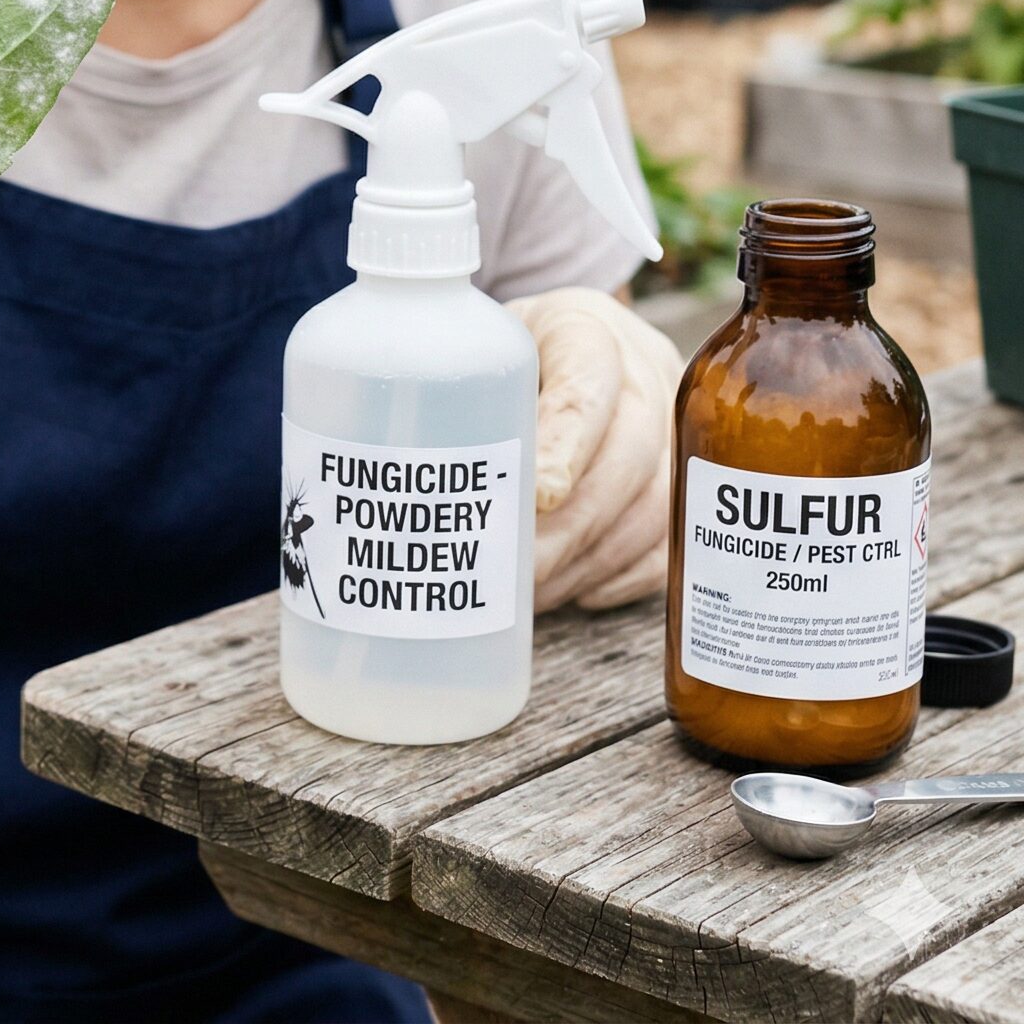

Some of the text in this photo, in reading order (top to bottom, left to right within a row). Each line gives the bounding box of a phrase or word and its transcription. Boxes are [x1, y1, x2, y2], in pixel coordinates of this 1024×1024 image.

[321, 452, 488, 494] FUNGICIDE
[336, 494, 492, 533] POWDERY
[715, 483, 882, 537] SULFUR
[347, 536, 479, 572] MILDEW
[694, 525, 902, 564] FUNGICIDE / PEST CTRL
[338, 574, 486, 611] CONTROL
[766, 571, 827, 593] 250ml
